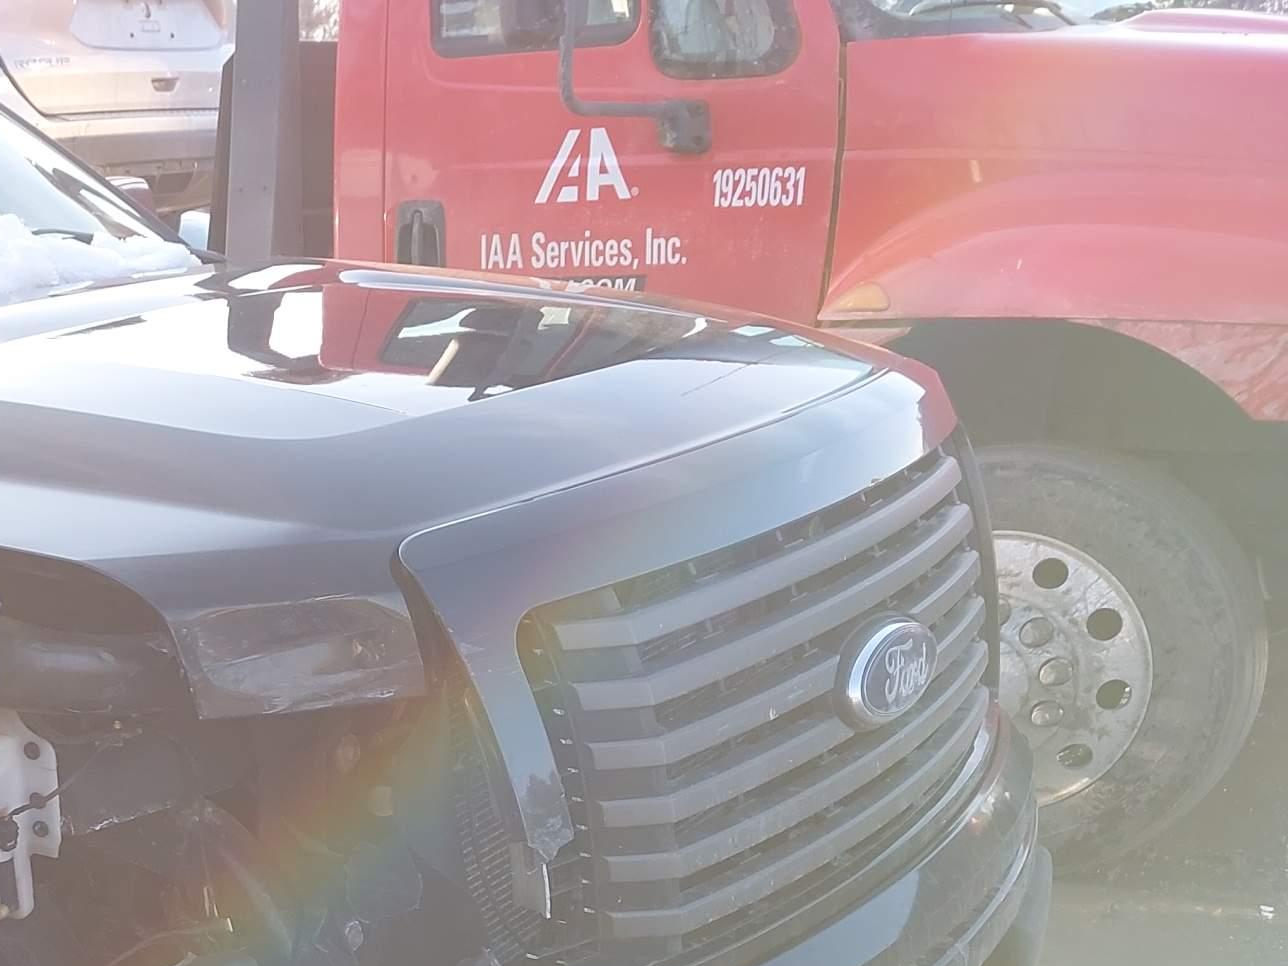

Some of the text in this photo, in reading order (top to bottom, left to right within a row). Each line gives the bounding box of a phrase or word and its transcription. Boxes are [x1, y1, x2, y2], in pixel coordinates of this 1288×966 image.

[713, 166, 806, 207] 19250631
[481, 227, 687, 269] IAA Services, Inc.
[885, 638, 928, 703] Ford
